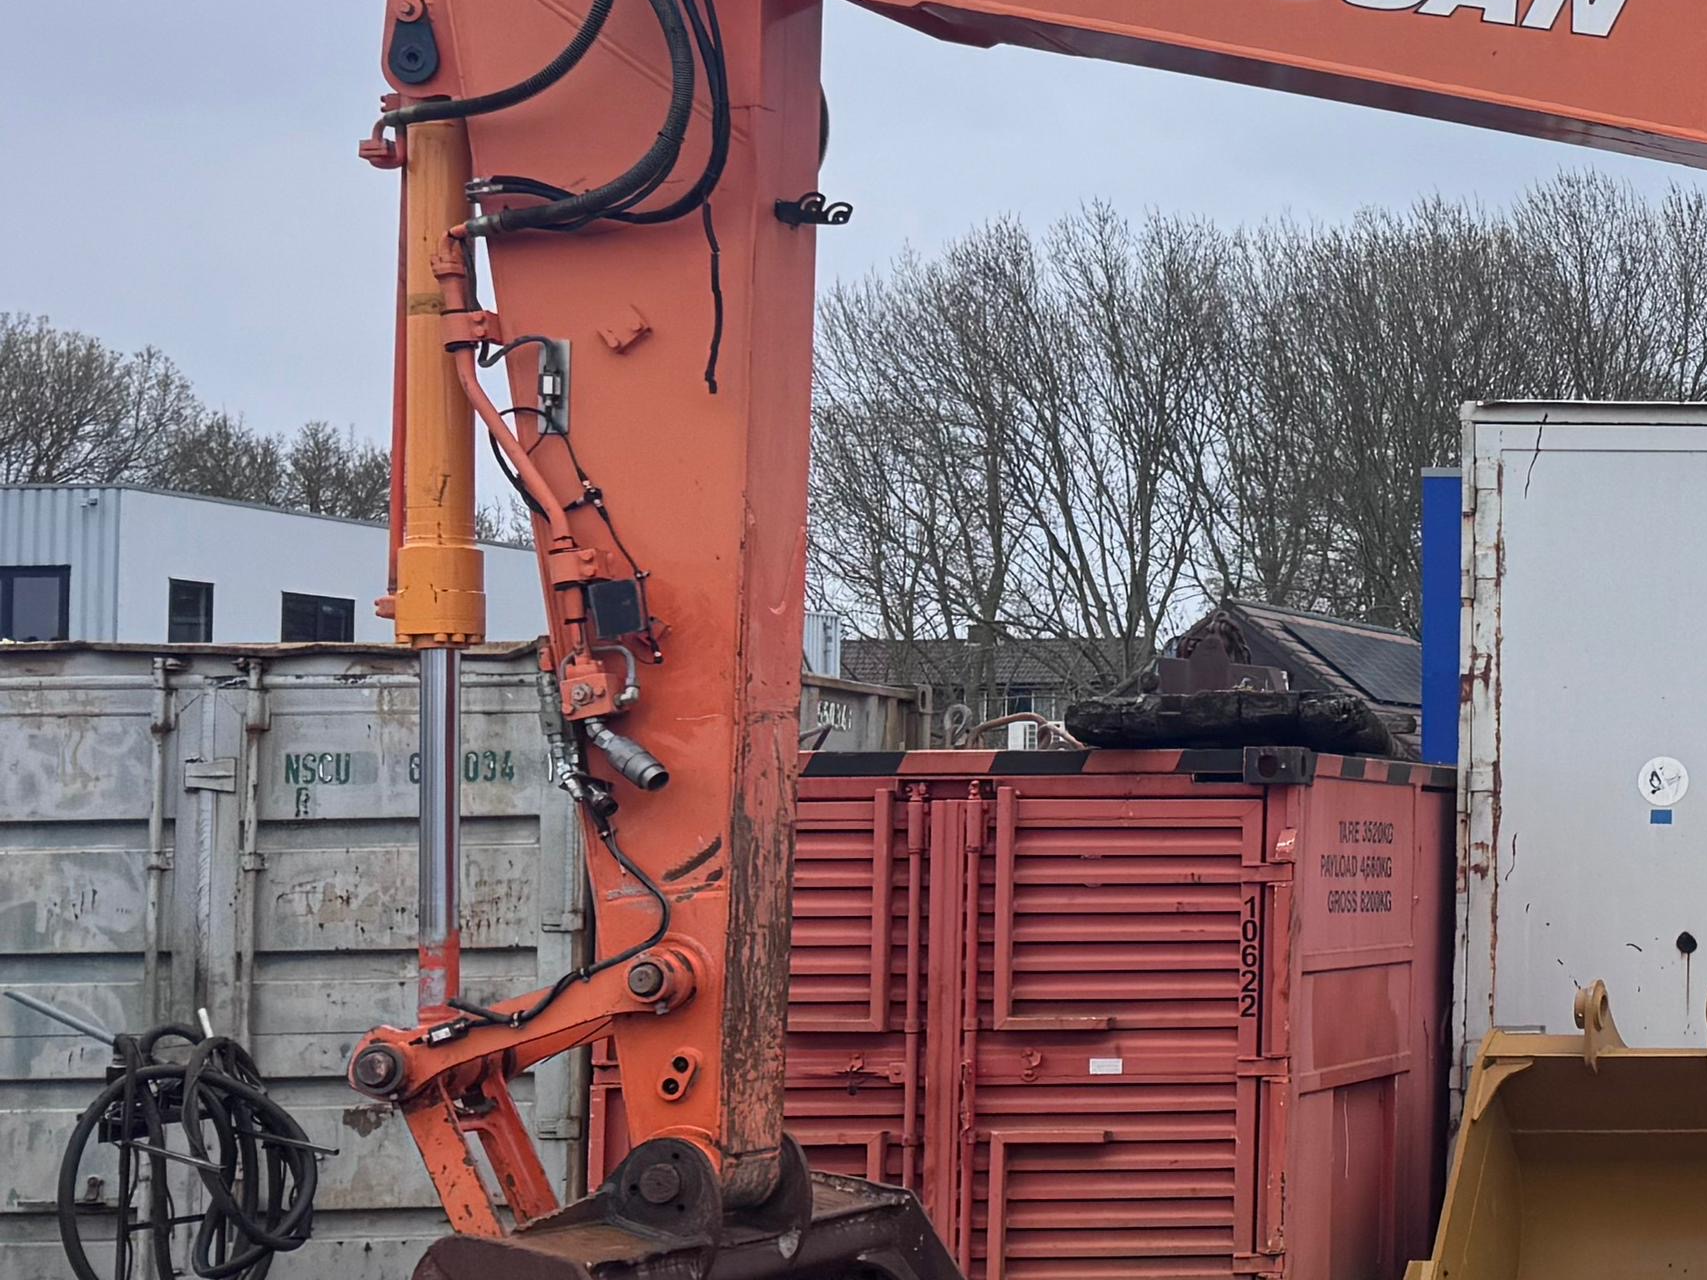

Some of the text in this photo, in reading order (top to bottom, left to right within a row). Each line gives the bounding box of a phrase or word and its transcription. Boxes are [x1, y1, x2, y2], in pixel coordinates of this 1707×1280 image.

[285, 752, 350, 785] NSCU
[1339, 820, 1360, 843] TARE
[1320, 854, 1358, 878] PAYLOAD
[1327, 889, 1358, 913] GROSS
[1240, 895, 1258, 1018] 10622
